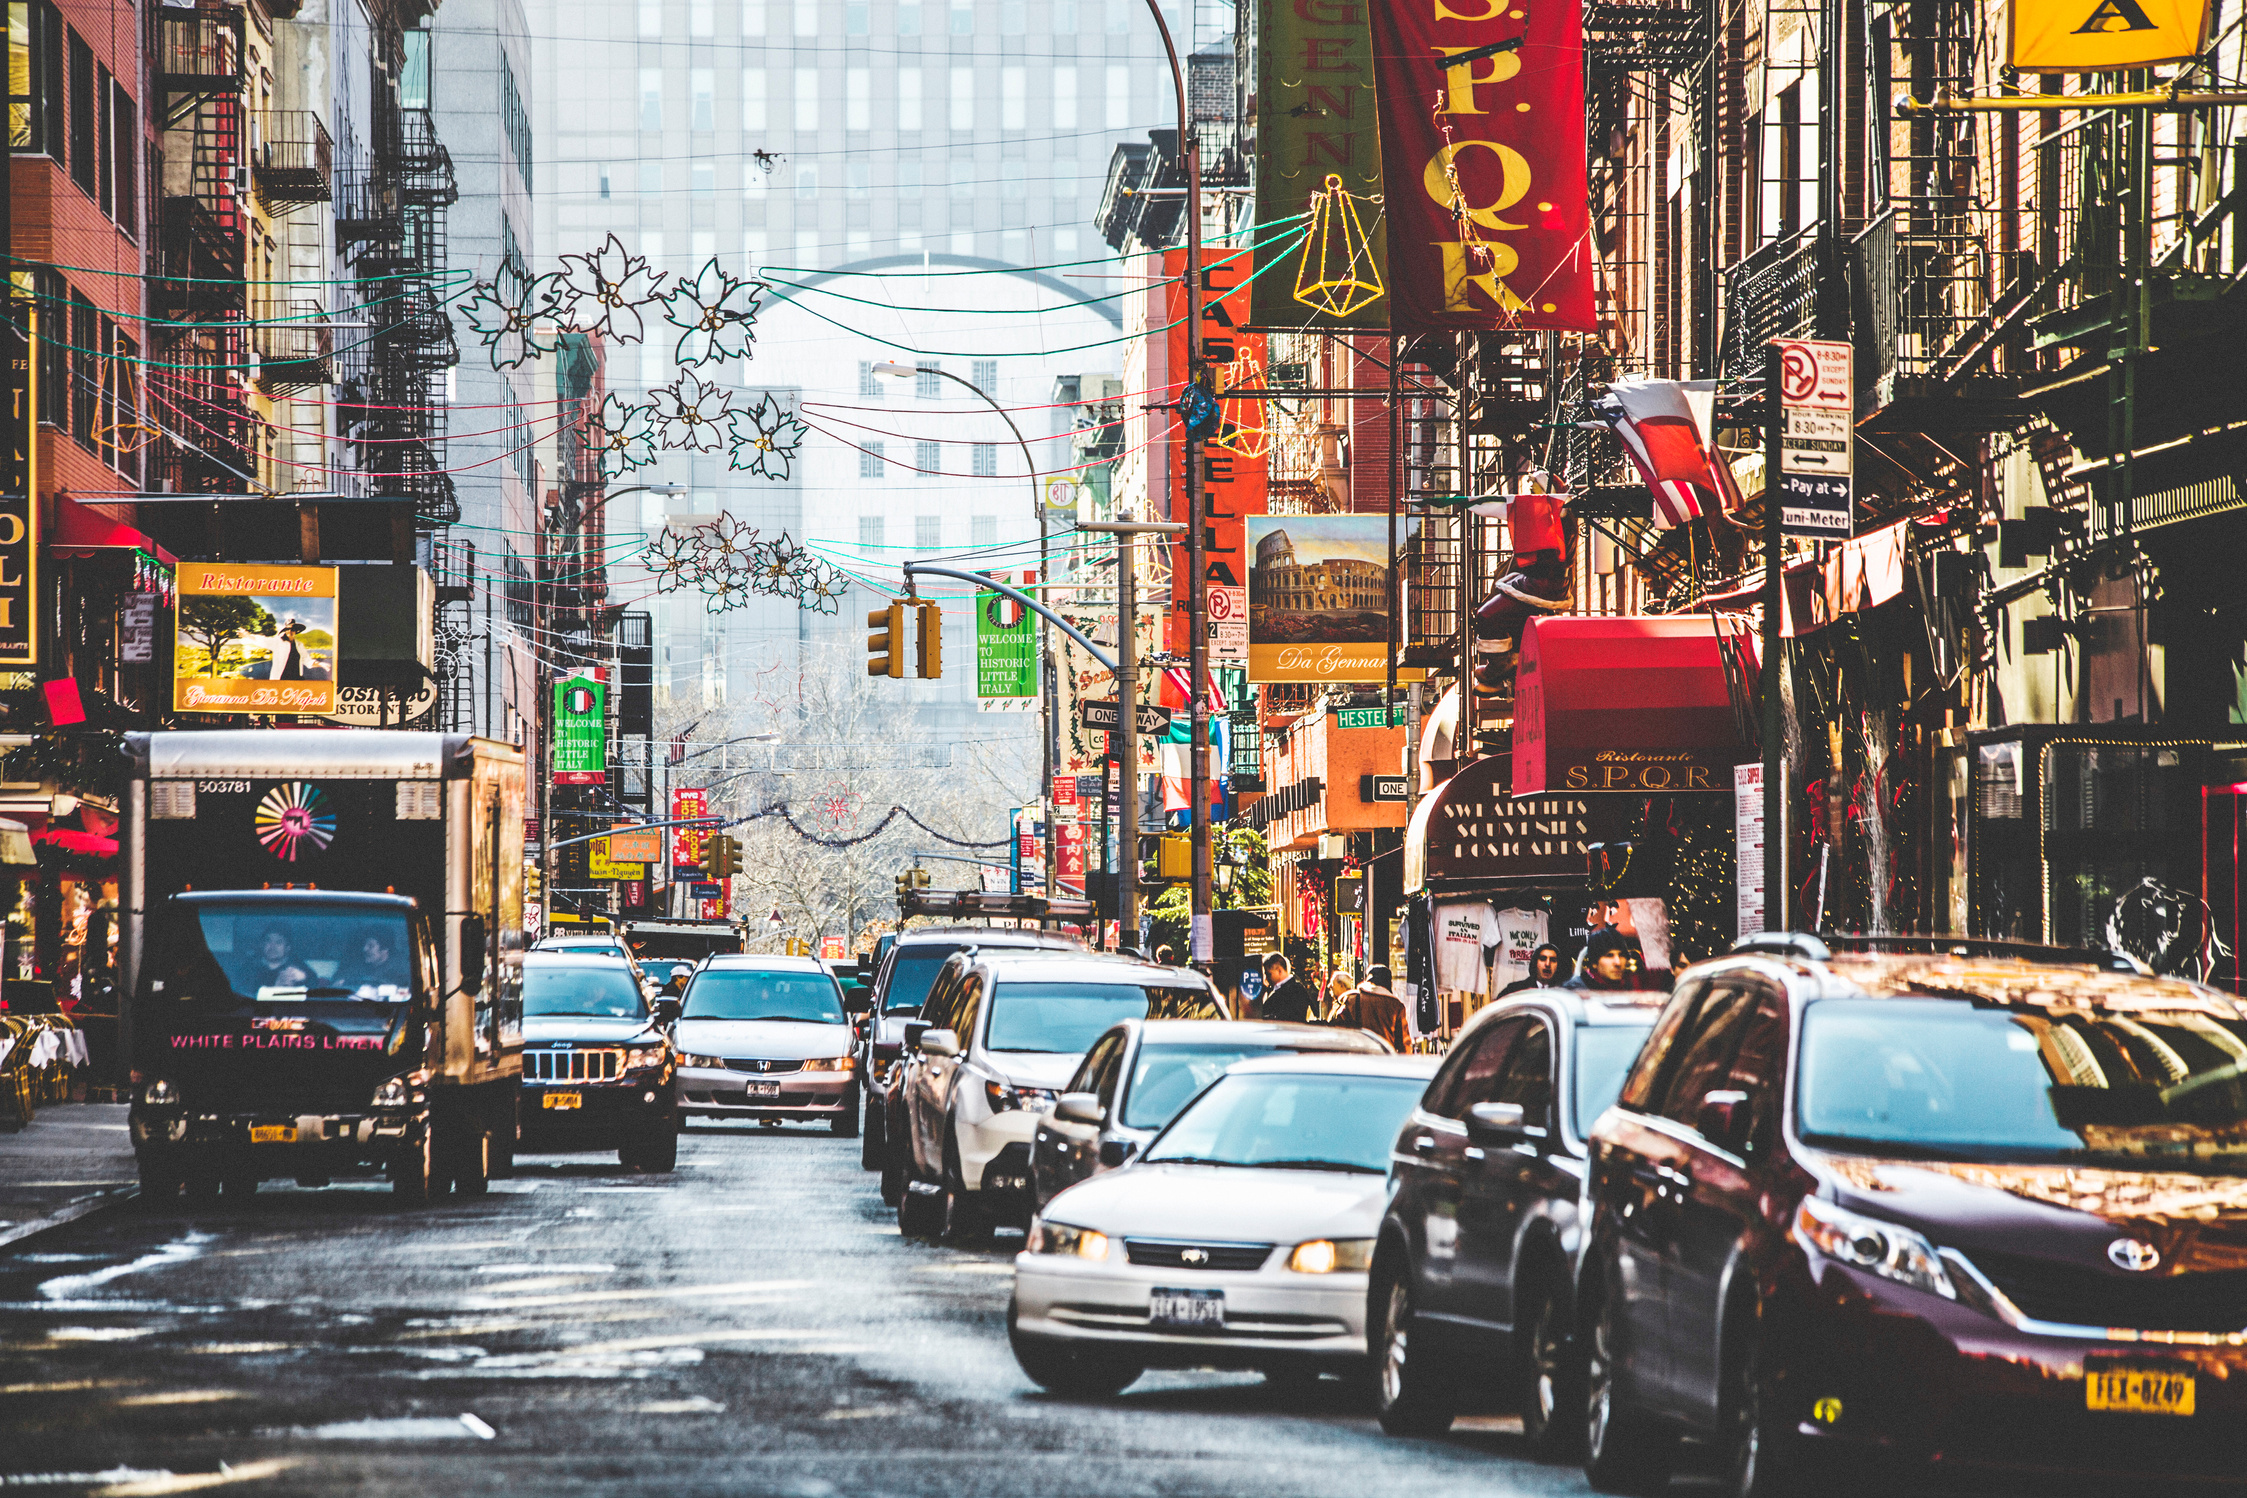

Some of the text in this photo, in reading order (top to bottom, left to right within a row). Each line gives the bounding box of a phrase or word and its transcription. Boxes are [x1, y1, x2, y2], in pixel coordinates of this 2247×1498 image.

[1822, 365, 1846, 374] EXCEPT
[1822, 377, 1846, 385] SUNDAY
[1816, 412, 1847, 421] PARKING
[1782, 438, 1843, 452] XCEPT SUNDAY
[1790, 478, 1830, 497] Pay at
[1782, 509, 1847, 527] uni-Meter
[199, 573, 314, 592] Ristorante
[1209, 623, 1216, 638] 2
[979, 634, 1033, 644] WELCOME
[1229, 639, 1245, 647] SUNDAY
[980, 647, 993, 657] TO
[980, 658, 1030, 668] HISTORIC
[1276, 645, 1388, 675] Da Gennar
[980, 671, 1018, 682] LITTLE
[980, 683, 1012, 694] ITALY
[555, 719, 602, 728] WELCOME
[1094, 709, 1160, 727] ONE WAY
[556, 729, 568, 738] TO
[556, 739, 600, 748] HISTORIC
[556, 749, 589, 759] LITTLE
[1595, 751, 1694, 762] Ristorante
[556, 760, 584, 769] ITALY
[1566, 766, 1721, 789] S.P.Q.R.
[198, 781, 251, 793] 503781
[1382, 783, 1404, 794] ONE
[1448, 919, 1480, 931] SURVIVED
[1448, 931, 1478, 940] ITALIAN
[1520, 930, 1539, 941] ONLY
[1243, 972, 1249, 983] P
[171, 1034, 386, 1050] WHITE PLAINS LINEN
